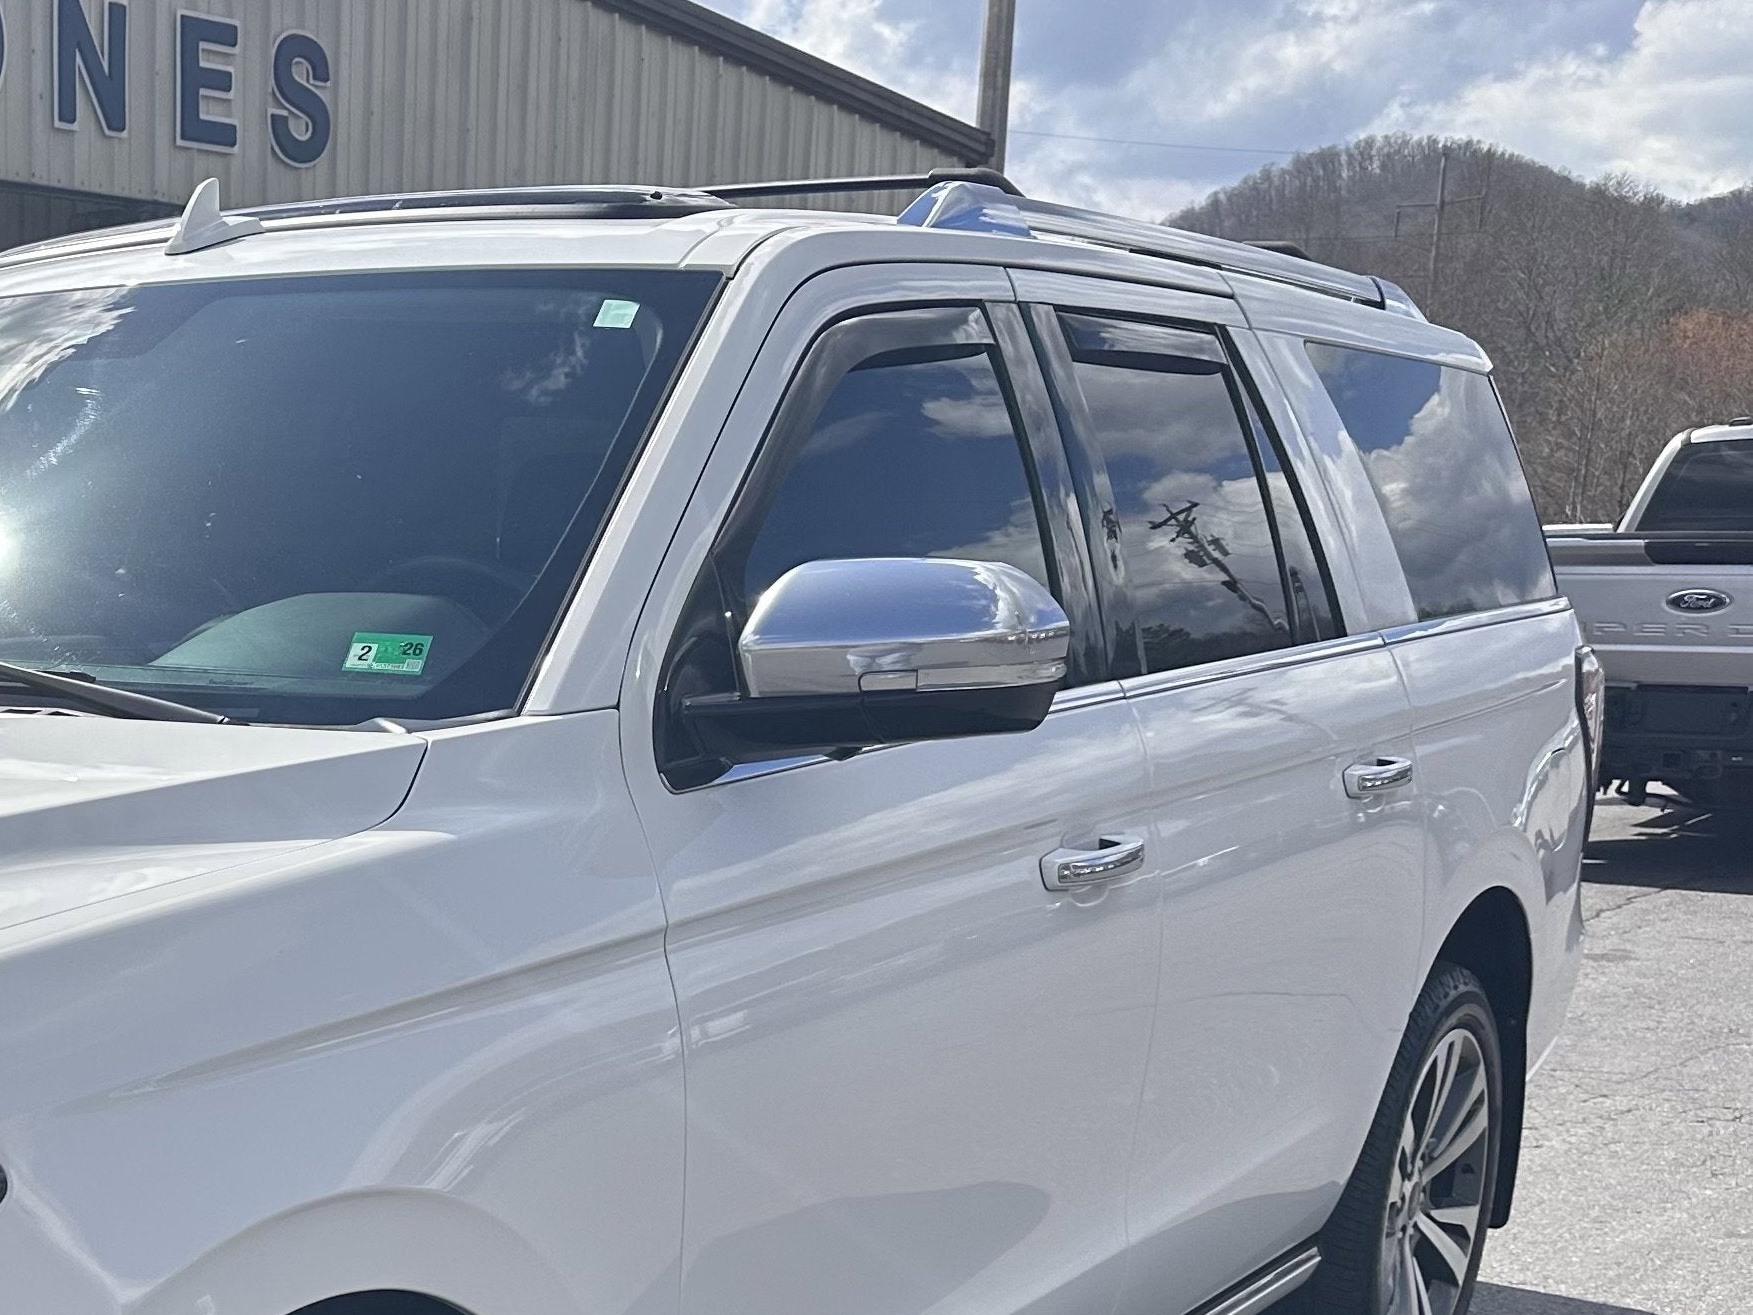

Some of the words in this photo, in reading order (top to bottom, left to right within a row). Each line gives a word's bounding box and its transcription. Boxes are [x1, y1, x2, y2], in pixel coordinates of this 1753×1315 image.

[1581, 621, 1710, 638] PER
[358, 645, 373, 661] 2
[401, 642, 425, 657] 26
